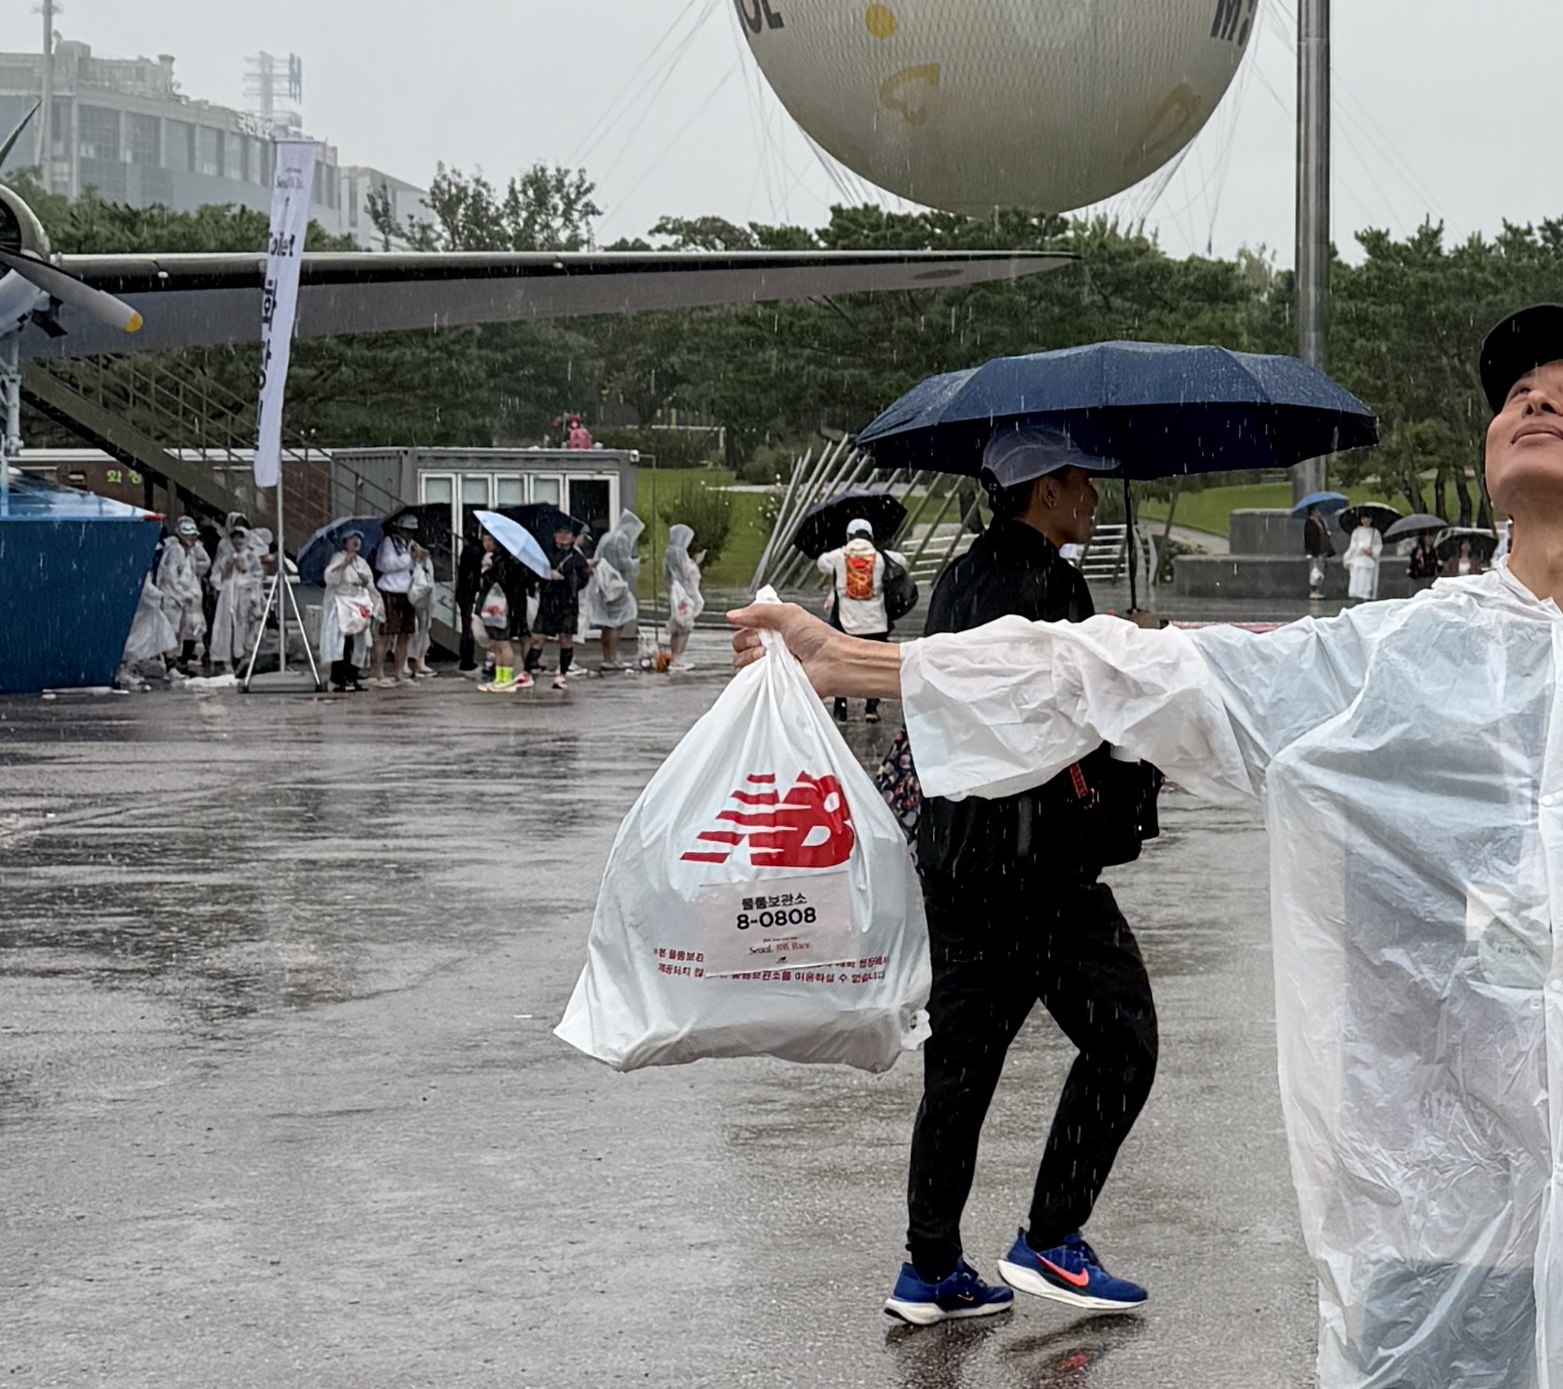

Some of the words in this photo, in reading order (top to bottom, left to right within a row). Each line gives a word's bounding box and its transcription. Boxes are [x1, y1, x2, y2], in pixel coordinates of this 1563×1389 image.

[742, 892, 808, 910] 물품보관소
[737, 907, 816, 930] 8-0808
[839, 973, 848, 982] 수
